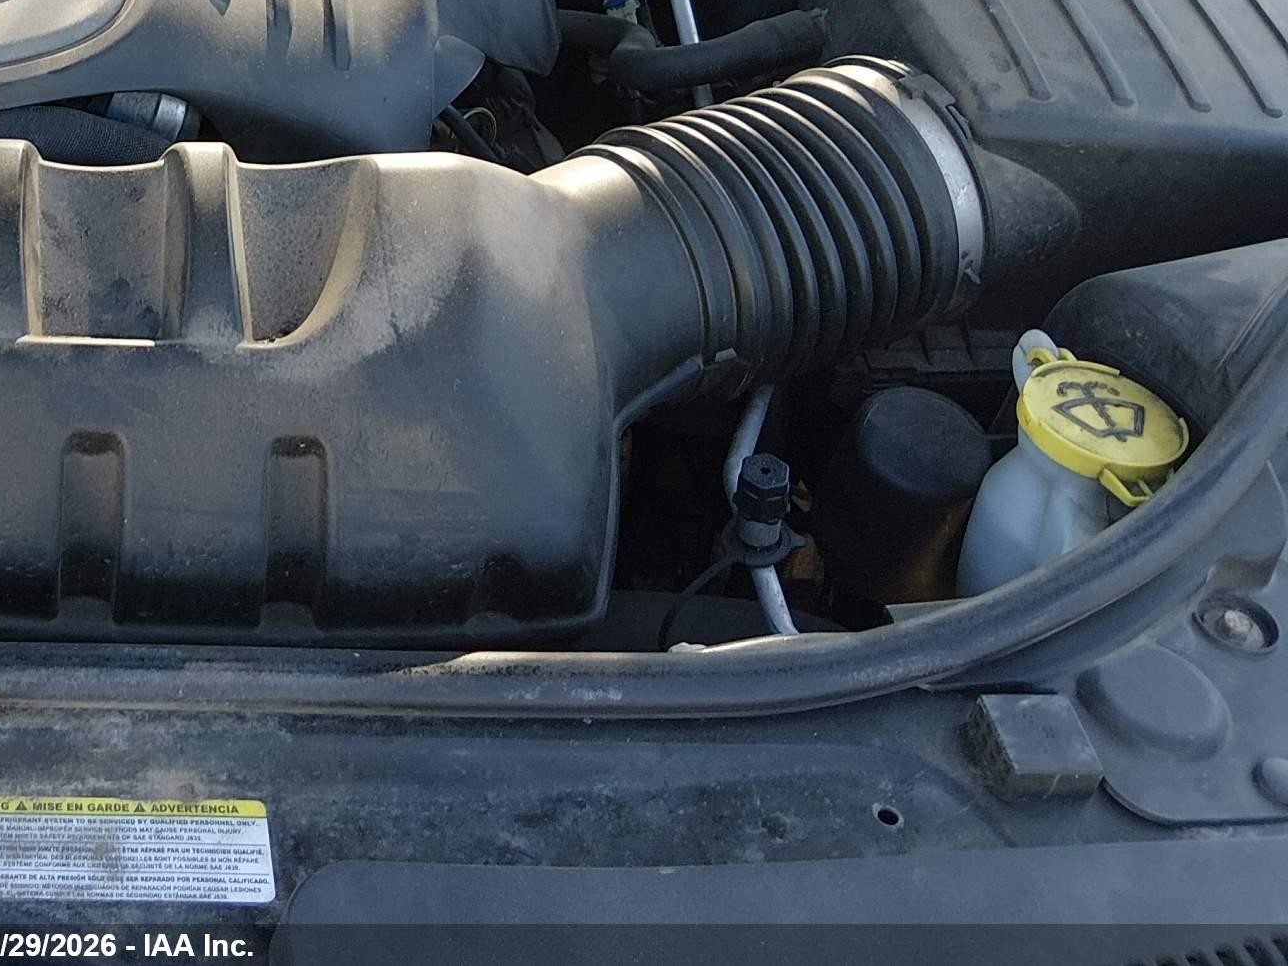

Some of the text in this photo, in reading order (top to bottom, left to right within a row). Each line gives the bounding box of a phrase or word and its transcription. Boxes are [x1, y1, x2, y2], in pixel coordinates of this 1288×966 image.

[33, 802, 63, 811] MISE
[67, 803, 83, 811] EN
[87, 803, 130, 812] GARDE
[151, 803, 239, 814] ADVERTENCIA
